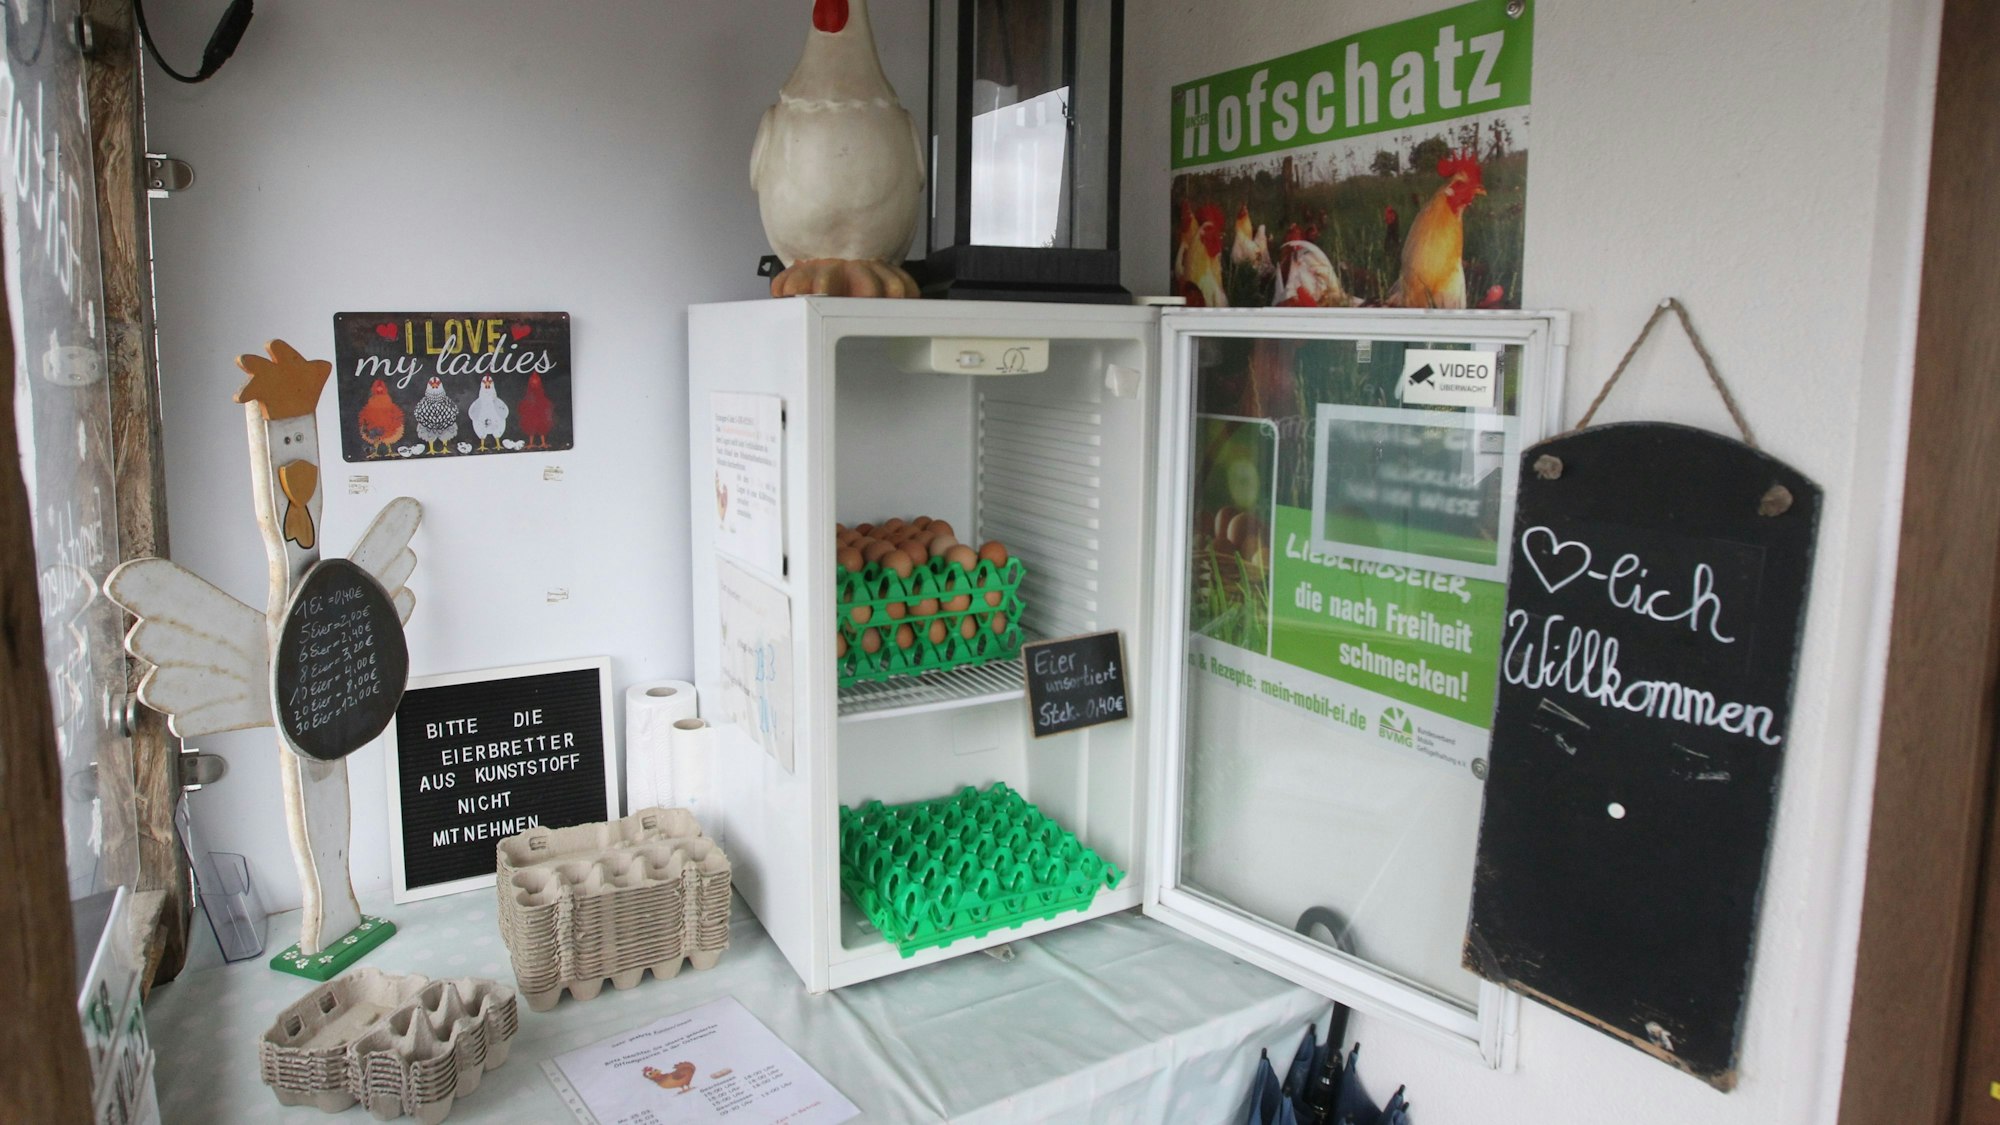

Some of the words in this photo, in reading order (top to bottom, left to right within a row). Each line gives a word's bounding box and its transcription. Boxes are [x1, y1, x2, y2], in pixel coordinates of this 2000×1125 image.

[1182, 24, 1506, 160] Hofschatz
[404, 318, 414, 355] I
[424, 319, 504, 355] LOVE
[354, 354, 423, 390] my
[435, 333, 558, 377] ladies
[1440, 363, 1488, 379] VIDEO
[1440, 383, 1488, 393] ÜBERWACHT
[295, 600, 307, 619] 1
[1295, 582, 1323, 613] die
[1329, 594, 1377, 628] nach
[1386, 602, 1473, 654] Freiheit
[299, 646, 308, 662] 6
[310, 642, 332, 657] Eier
[1035, 649, 1076, 675] Eier
[300, 665, 308, 683] 8
[311, 663, 334, 677] Eier
[310, 677, 333, 695] Eier
[1045, 661, 1117, 692] unsortiert
[1338, 642, 1469, 702] schmecken!
[1504, 609, 1782, 745] Willkommen
[1199, 653, 1207, 670] &
[1211, 657, 1256, 689] Rezepte:
[1260, 676, 1367, 731] mein-mobil-ei.de
[294, 705, 309, 721] 20
[311, 695, 332, 712] Eier
[296, 721, 309, 736] 30
[312, 711, 333, 728] Eier
[426, 718, 479, 740] BITTE
[513, 709, 543, 728] DIE
[441, 732, 575, 766] EIERBRETTER
[1379, 728, 1413, 748] BVMG
[419, 772, 456, 793] AUS
[475, 753, 581, 784] KUNSTSTOFF
[458, 791, 512, 815] NICHT
